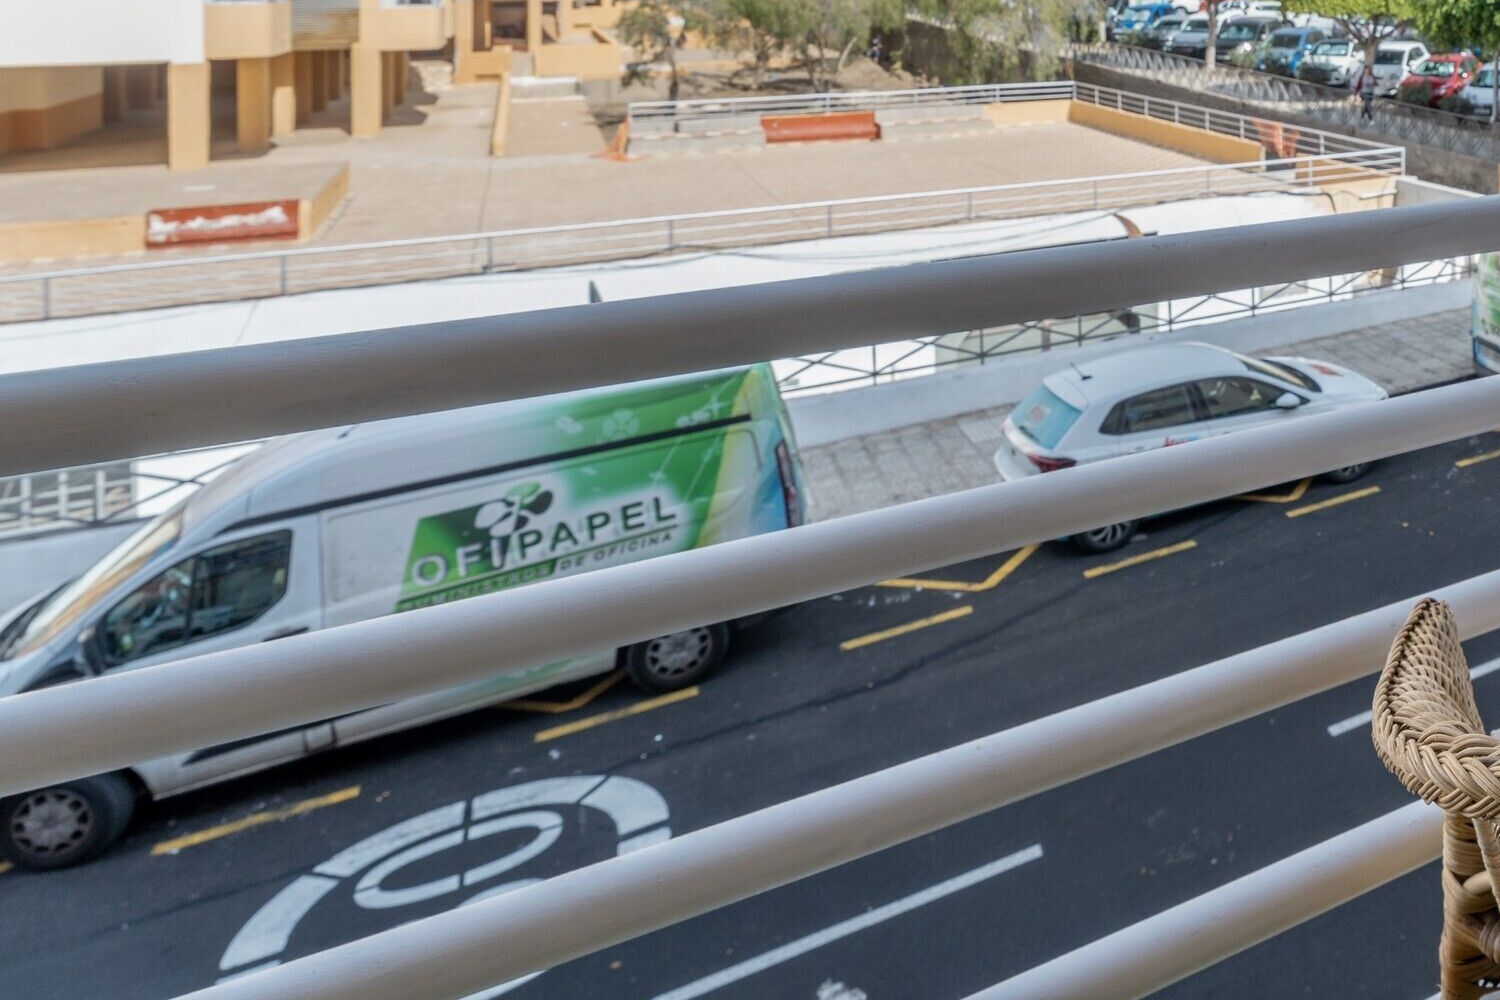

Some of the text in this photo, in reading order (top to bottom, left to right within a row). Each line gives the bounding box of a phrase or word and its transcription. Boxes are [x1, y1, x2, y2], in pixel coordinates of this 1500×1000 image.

[411, 496, 677, 587] OFIPAPEL
[559, 555, 585, 571] DE
[594, 533, 672, 561] OFICINA
